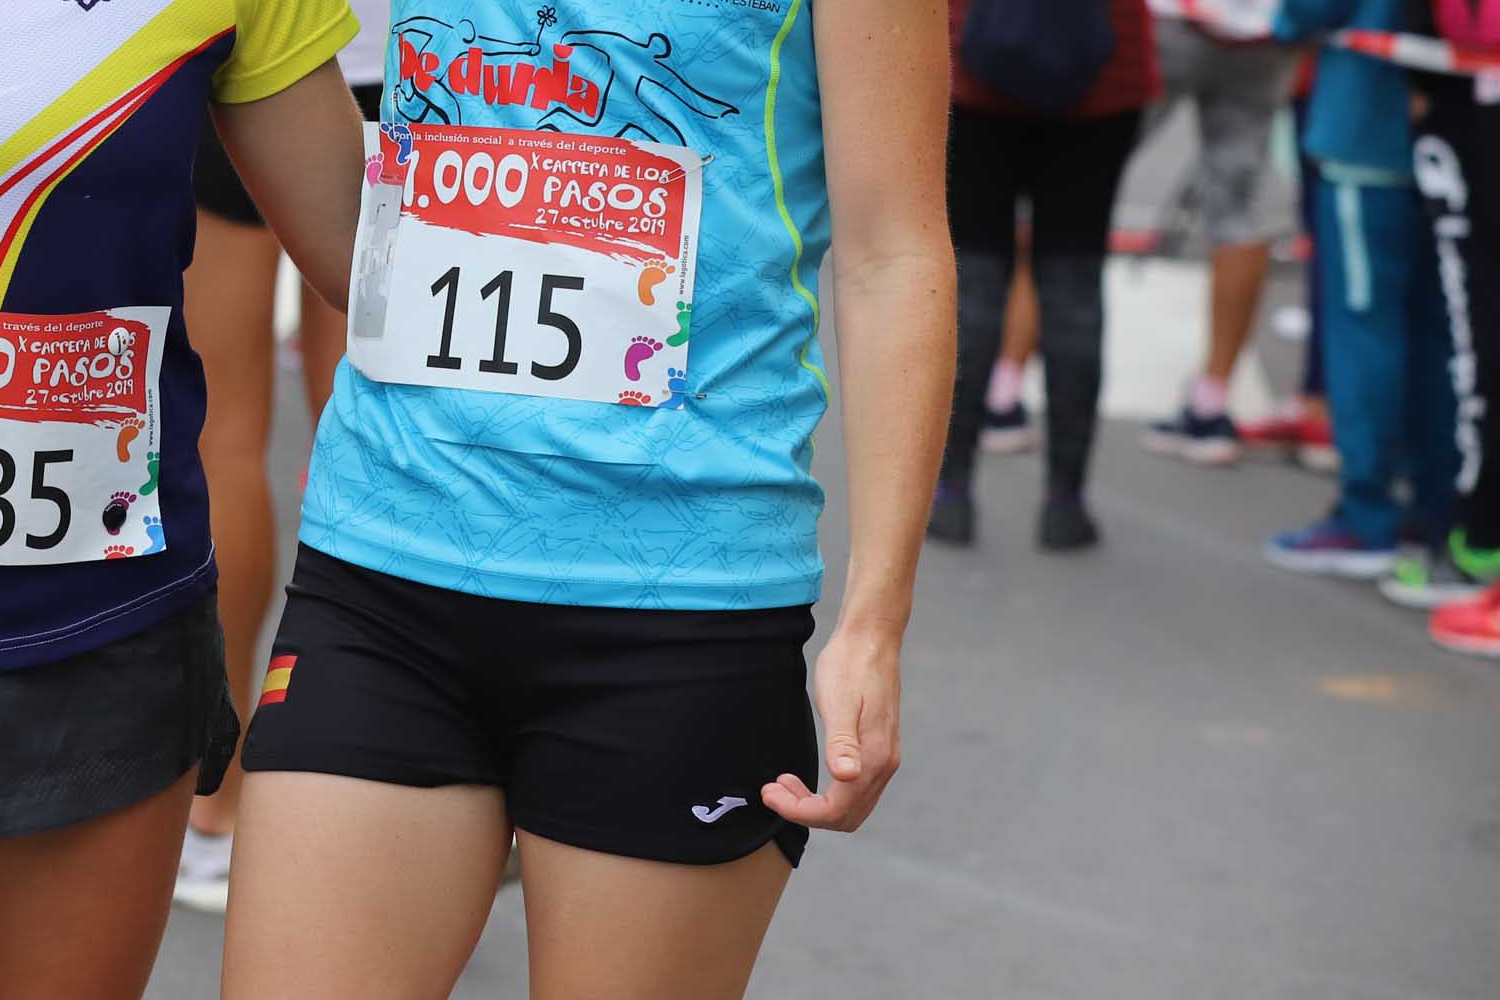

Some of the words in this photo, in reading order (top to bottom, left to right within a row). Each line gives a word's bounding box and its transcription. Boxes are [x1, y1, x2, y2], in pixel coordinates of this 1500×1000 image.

[393, 130, 411, 140] Por
[412, 131, 422, 140] la
[424, 131, 470, 143] inclusión
[472, 135, 502, 145] social
[518, 138, 553, 149] través
[556, 140, 575, 150] del
[578, 143, 627, 156] deporte
[403, 149, 529, 209] 1.000
[530, 151, 541, 170] X
[614, 165, 631, 179] DE
[636, 165, 669, 184] LOS
[543, 175, 669, 218] PASOS
[535, 208, 560, 225] 27
[561, 212, 625, 231] octubre
[627, 216, 666, 236] 2019
[3, 321, 40, 332] través
[44, 321, 62, 332] del
[66, 319, 104, 333] deporte
[426, 266, 585, 381] 115
[17, 335, 28, 353] X
[94, 335, 106, 349] DE
[32, 350, 135, 387] PASOS
[25, 388, 49, 405] 27
[51, 384, 104, 404] octubre
[106, 379, 134, 399] 2019
